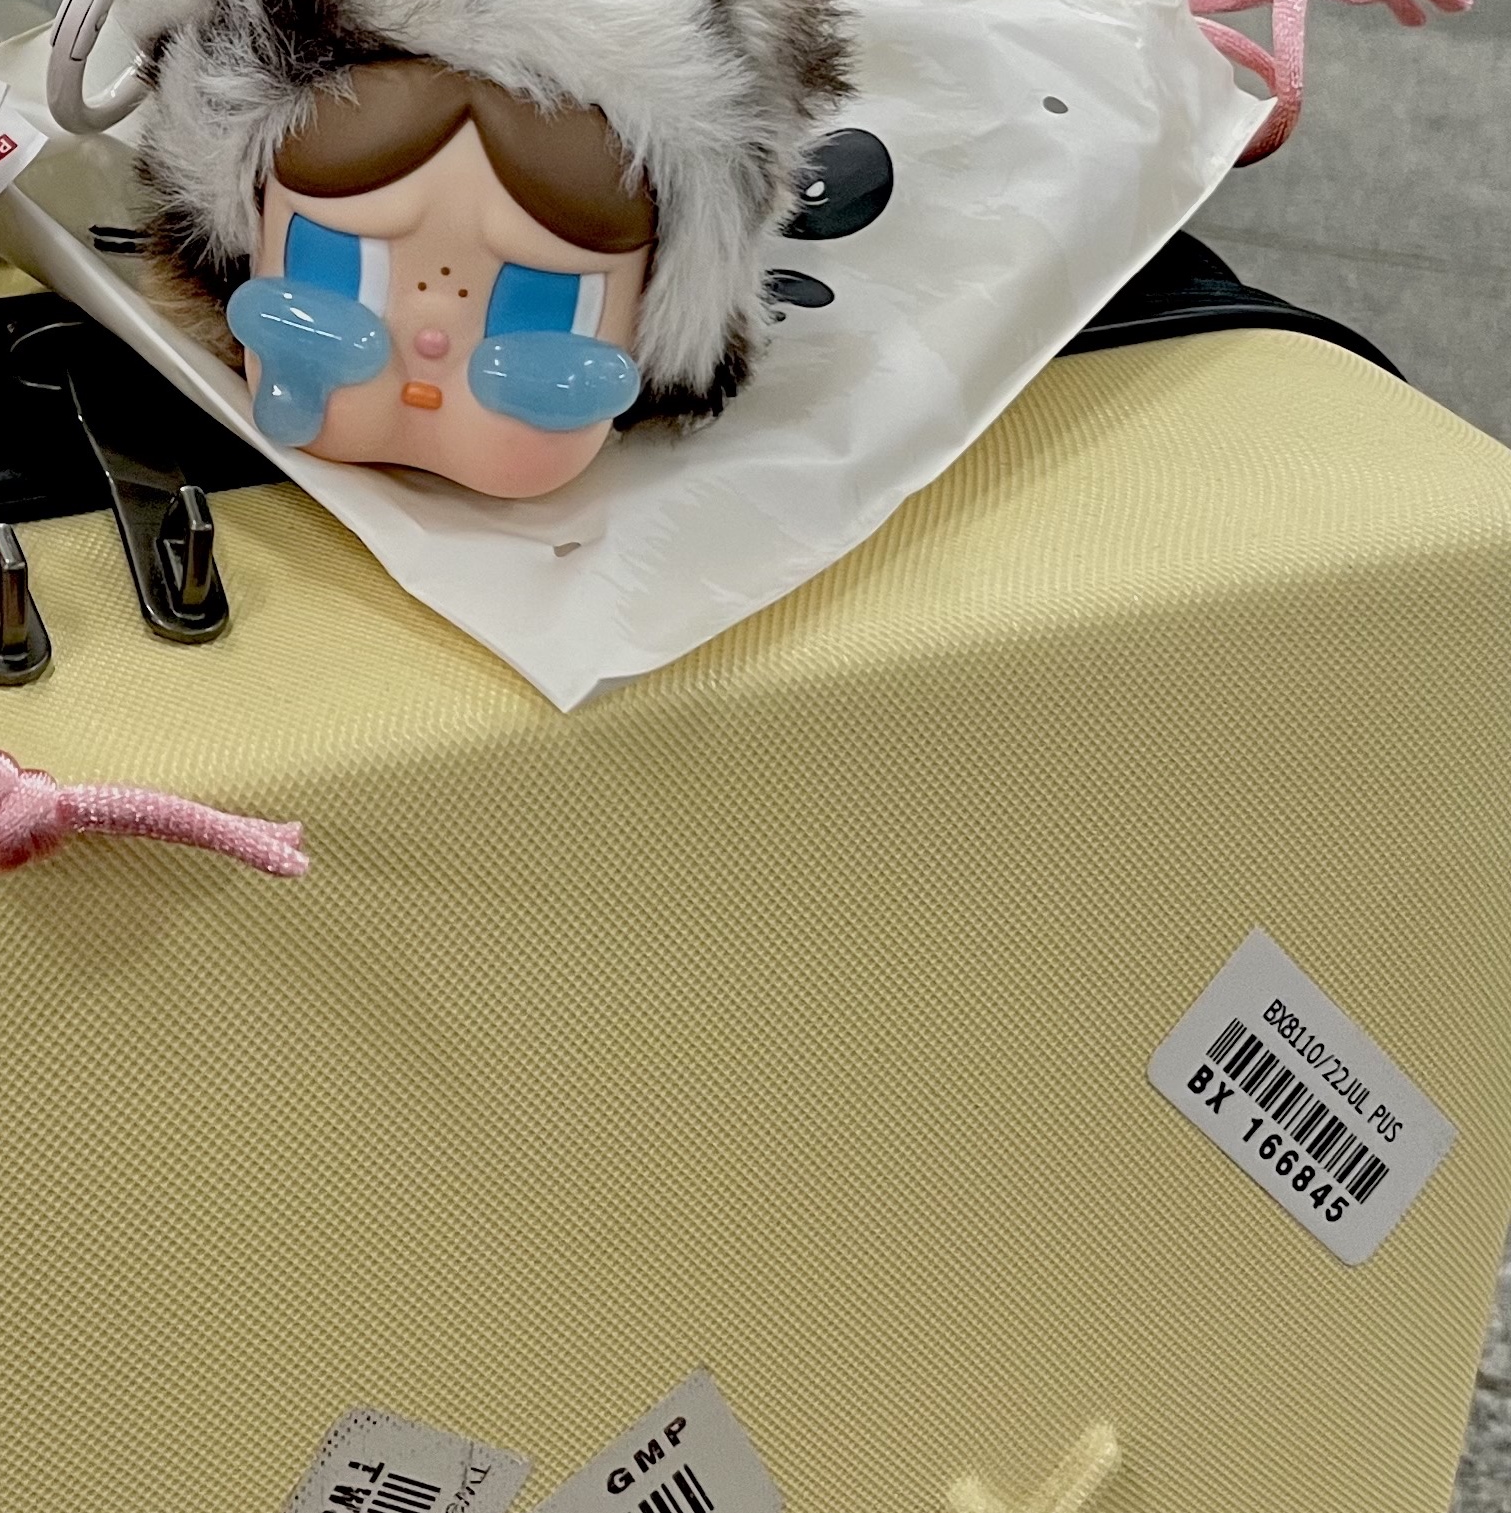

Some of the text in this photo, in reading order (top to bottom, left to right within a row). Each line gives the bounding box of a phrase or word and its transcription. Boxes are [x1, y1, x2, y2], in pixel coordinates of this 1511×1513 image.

[1262, 998, 1404, 1144] BX8110/22JUL PUS
[1187, 1063, 1350, 1223] BX 166845
[323, 1461, 385, 1513] TW
[606, 1416, 688, 1495] GMP
